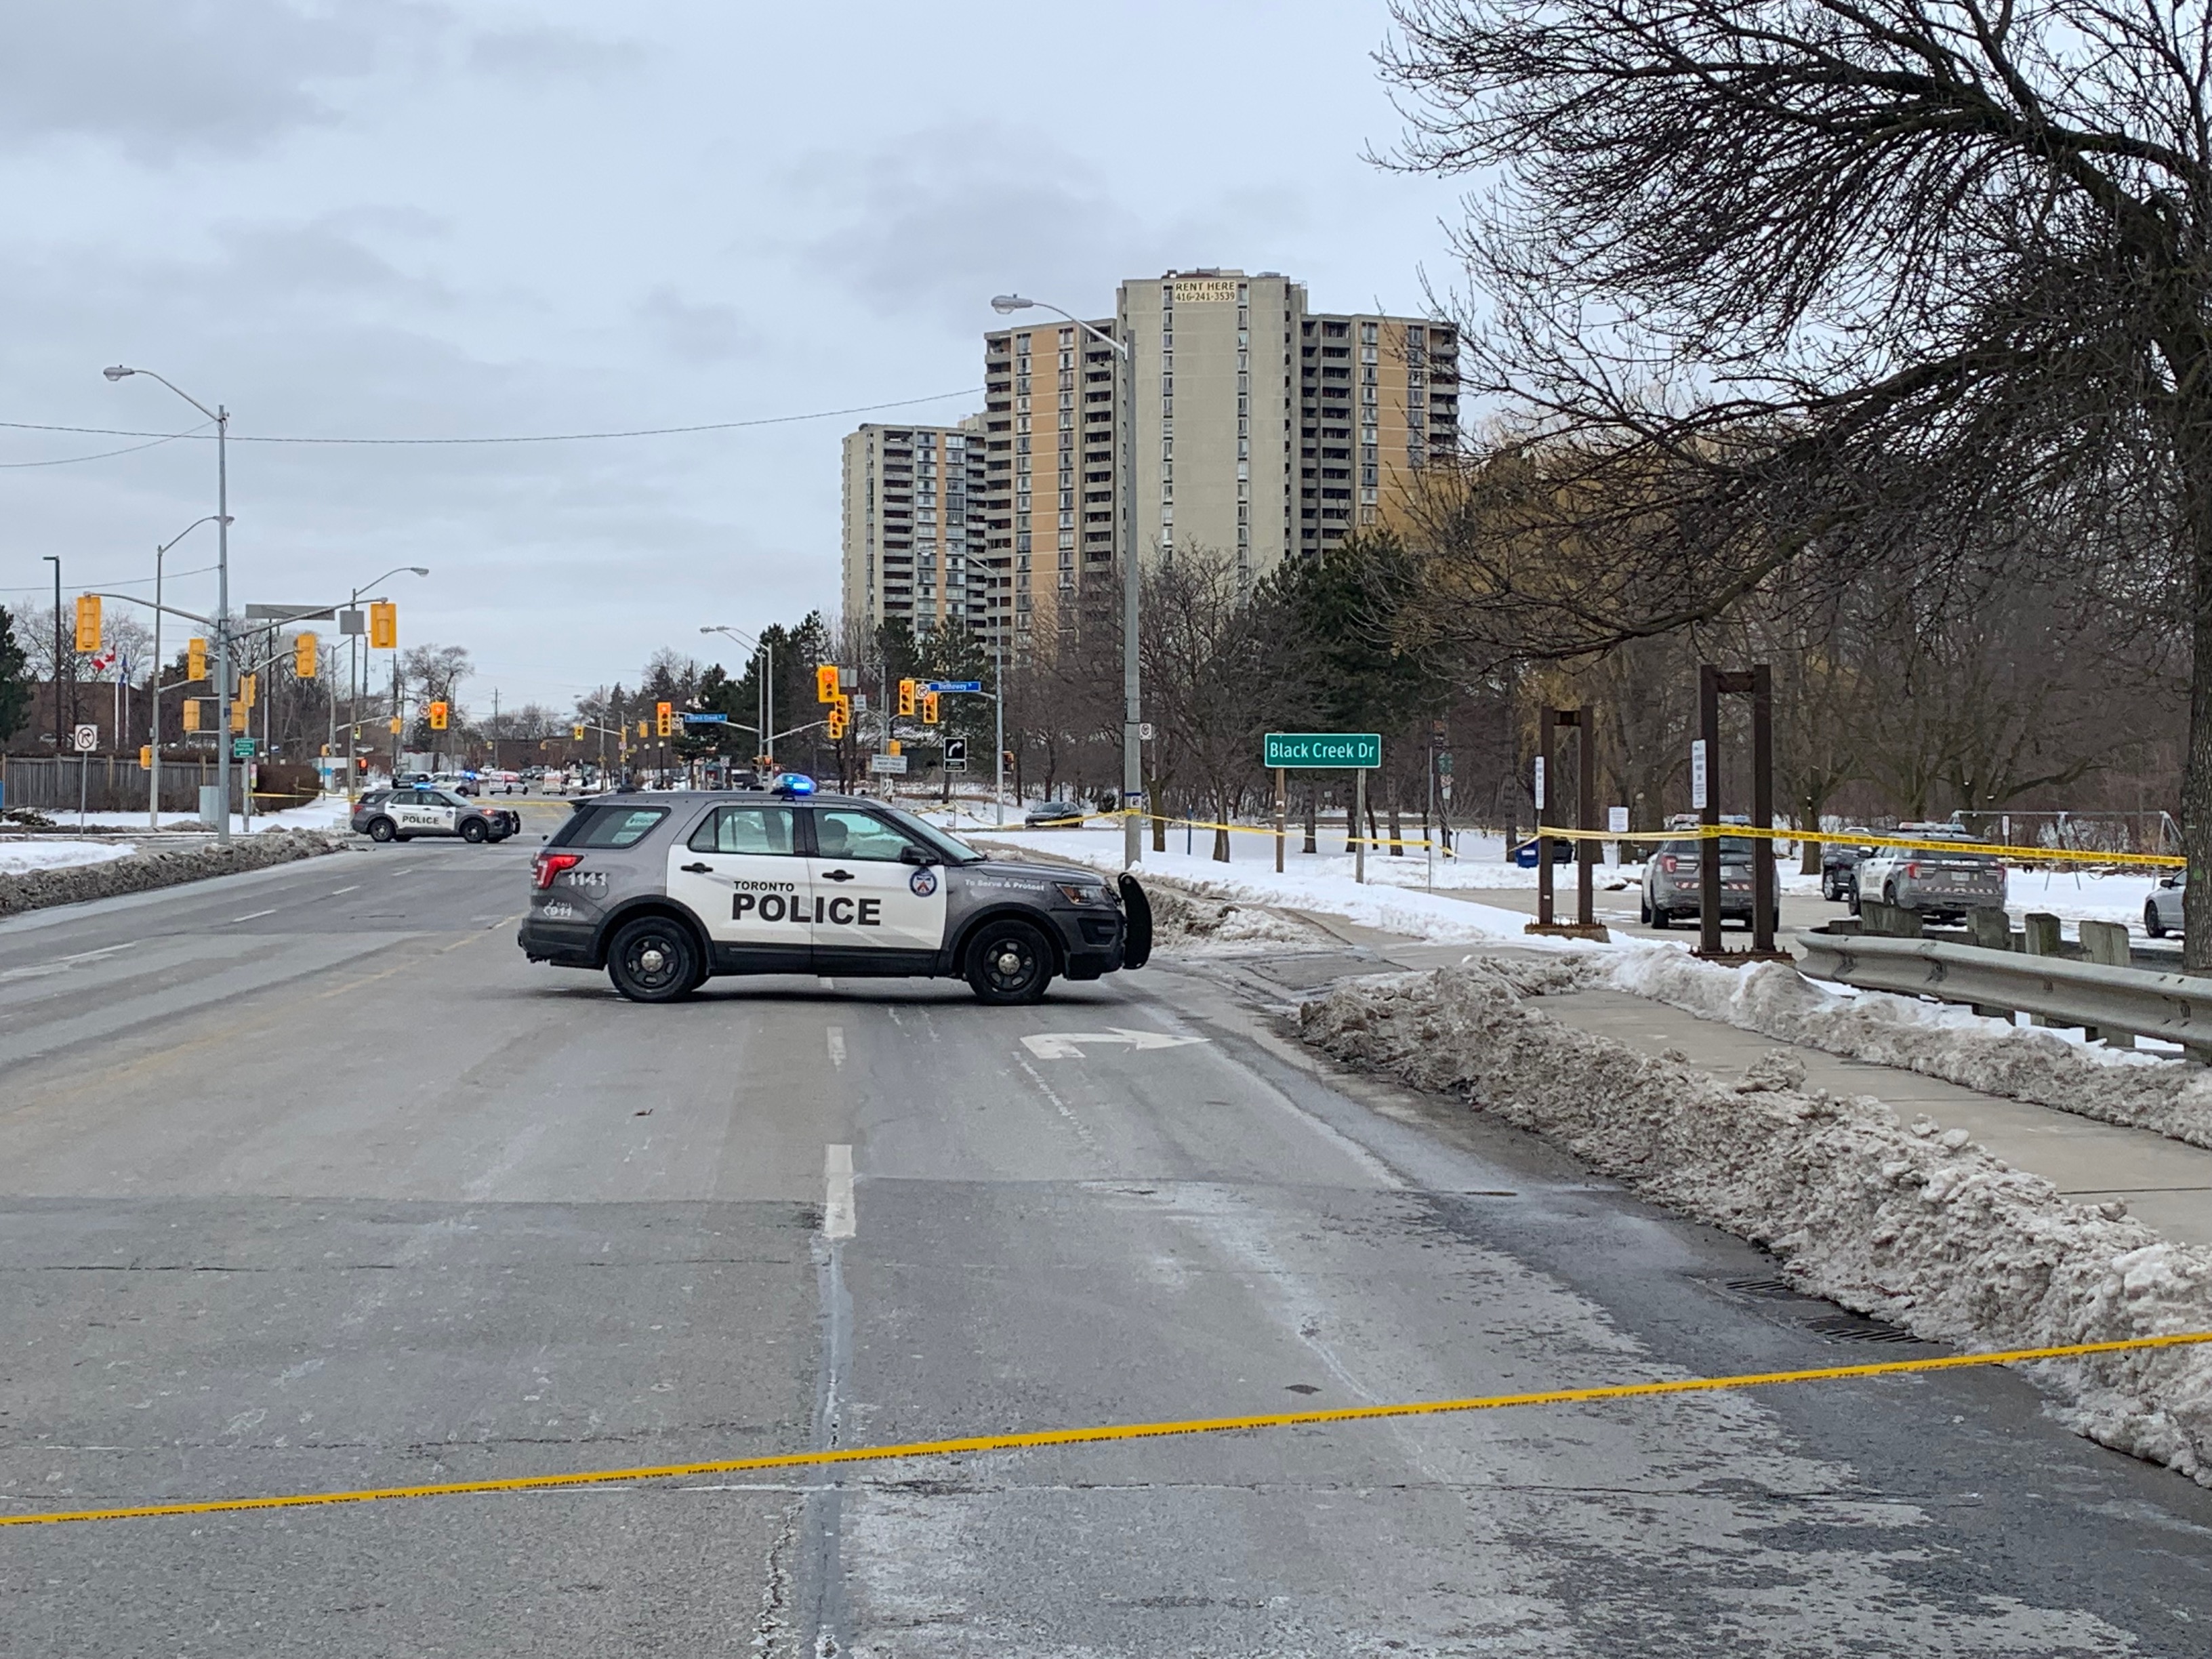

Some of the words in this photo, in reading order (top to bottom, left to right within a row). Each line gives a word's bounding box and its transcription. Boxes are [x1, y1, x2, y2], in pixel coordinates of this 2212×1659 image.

[1176, 282, 1204, 291] RENT
[1207, 281, 1235, 291] HERE
[1176, 291, 1235, 301] 416-241-3539
[1270, 742, 1309, 758] Black
[1313, 742, 1354, 758] Creek
[1358, 743, 1374, 758] Dr
[402, 815, 439, 825] POLICE
[568, 872, 607, 886] 1141
[733, 880, 795, 892] TORONTO
[977, 880, 1002, 888] Serve
[1013, 882, 1045, 891] Protect
[550, 905, 572, 917] 911
[732, 893, 881, 926] POLICE
